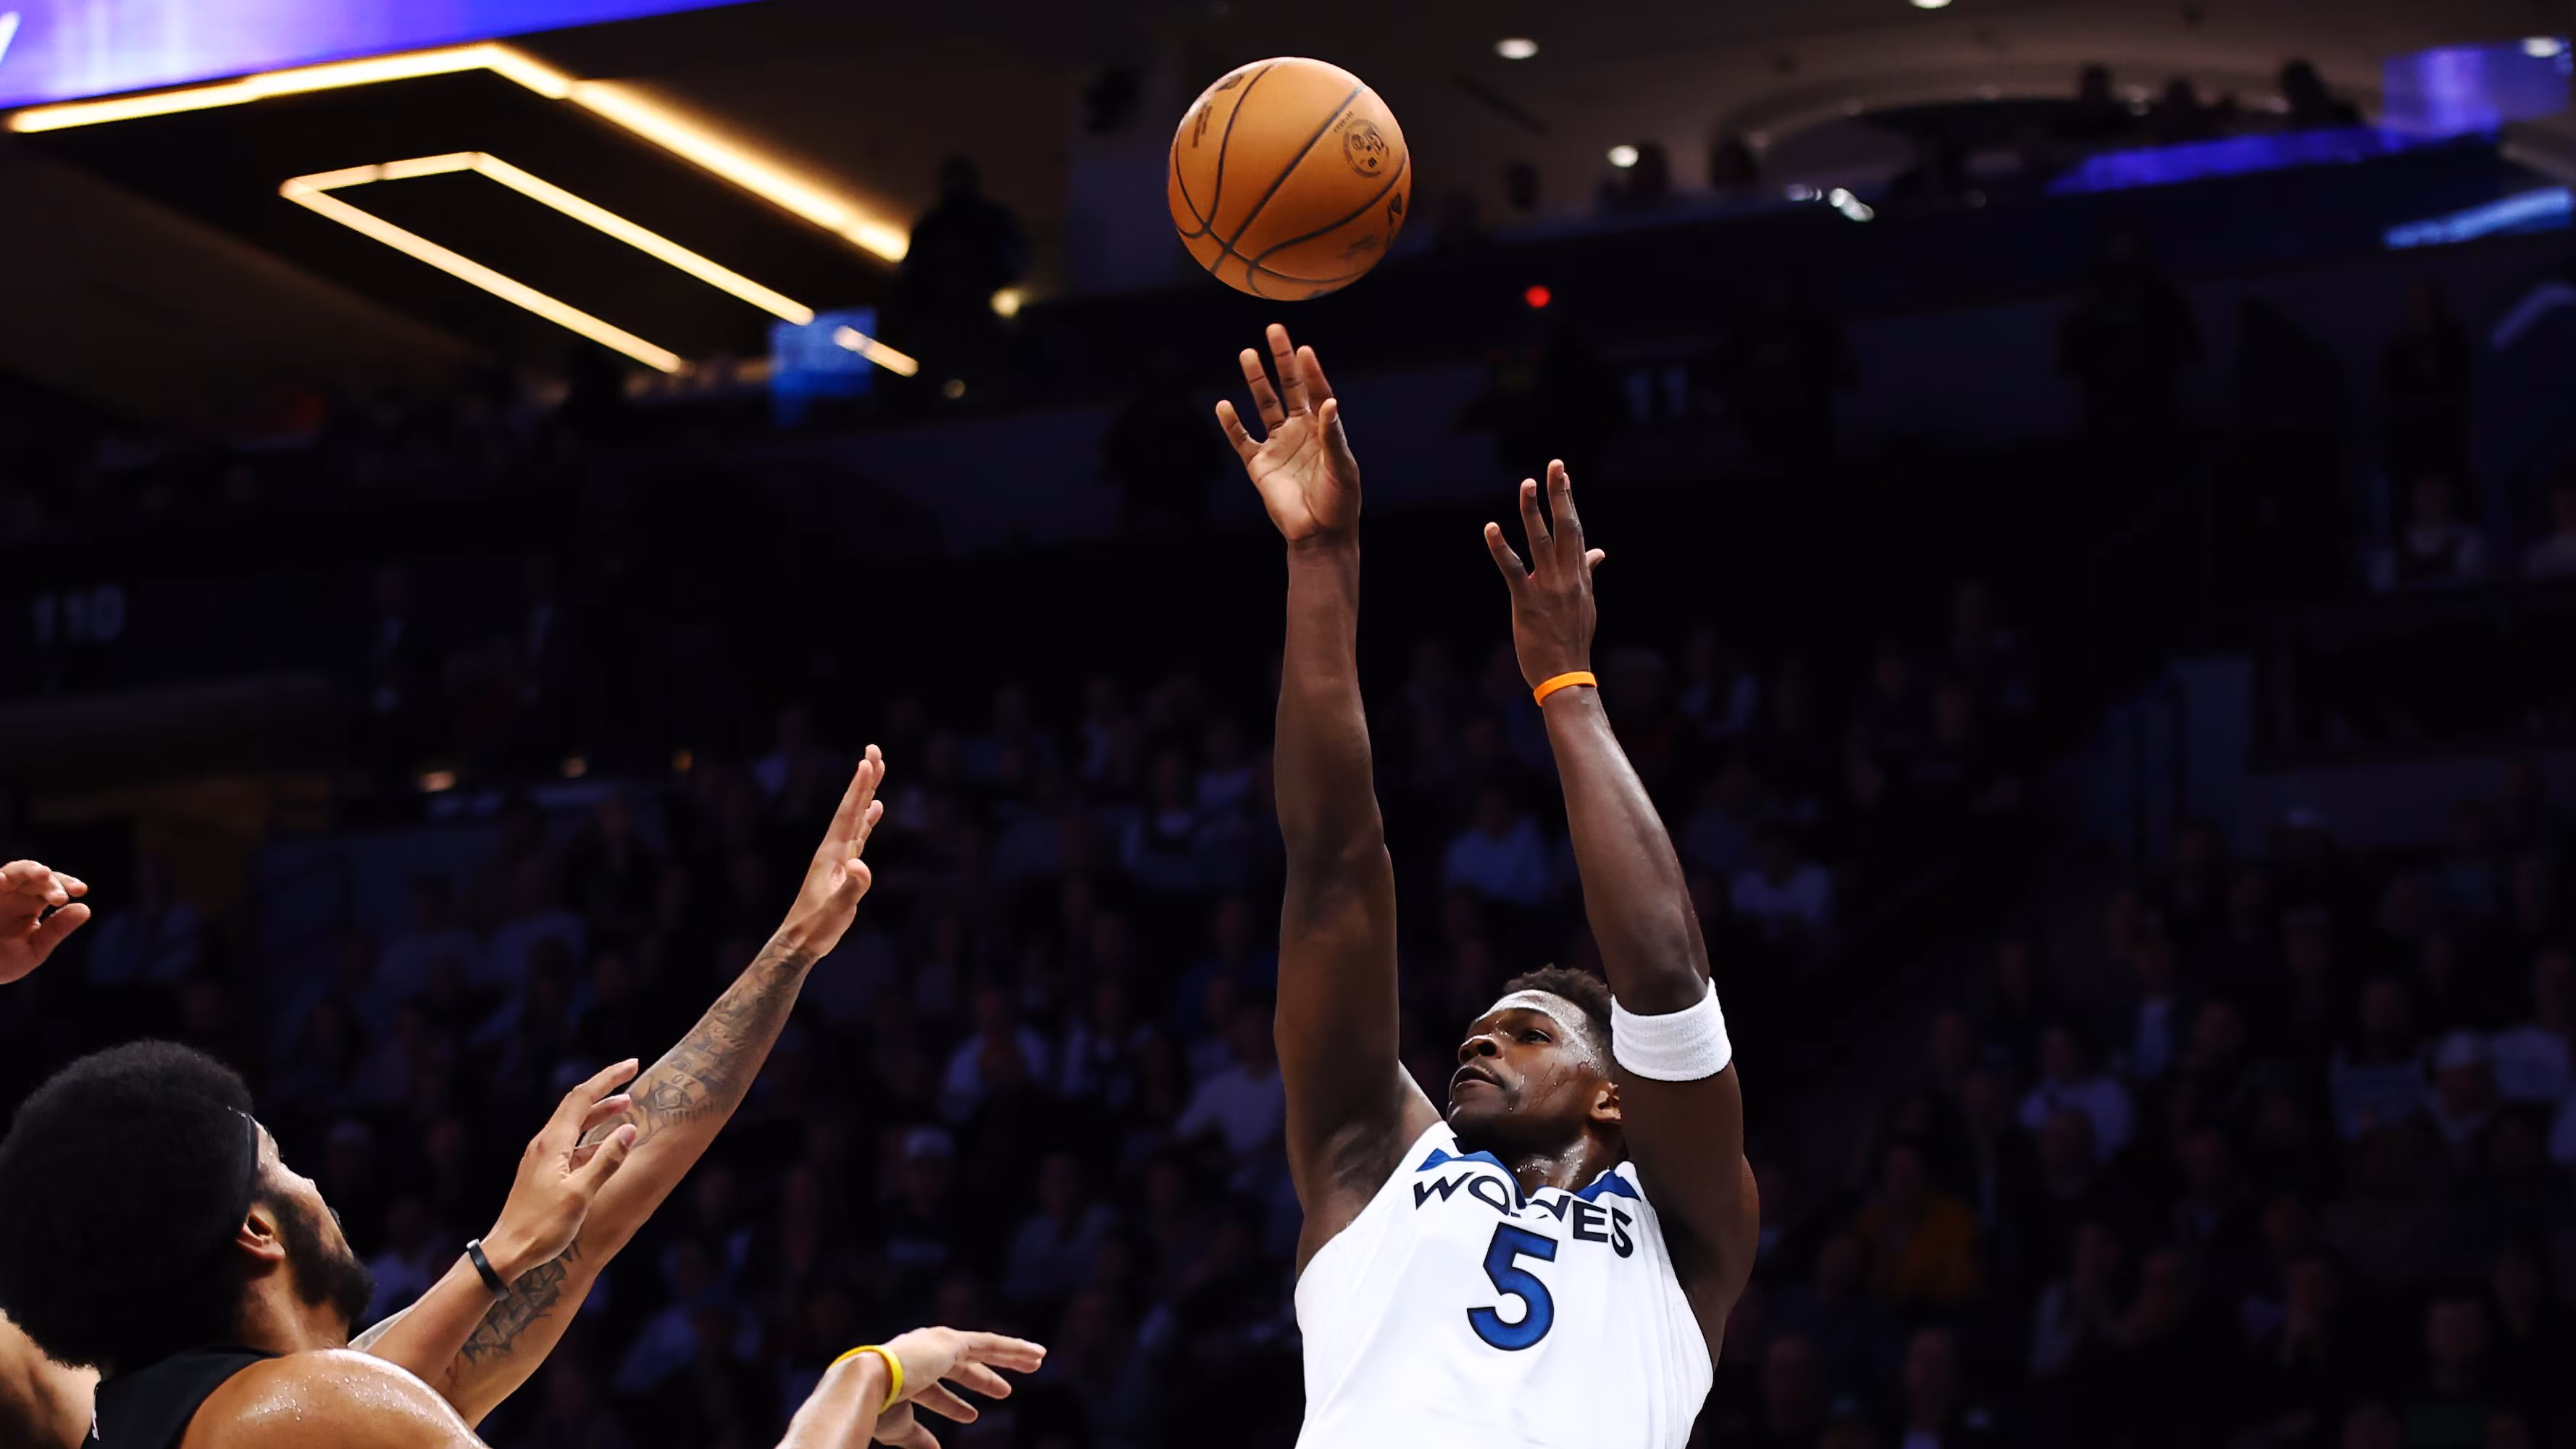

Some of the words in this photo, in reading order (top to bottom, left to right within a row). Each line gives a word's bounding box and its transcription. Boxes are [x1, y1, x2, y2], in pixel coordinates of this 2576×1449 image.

[31, 582, 127, 645] 110
[1413, 1172, 1633, 1258] WOVES
[1466, 1222, 1558, 1350] 5
